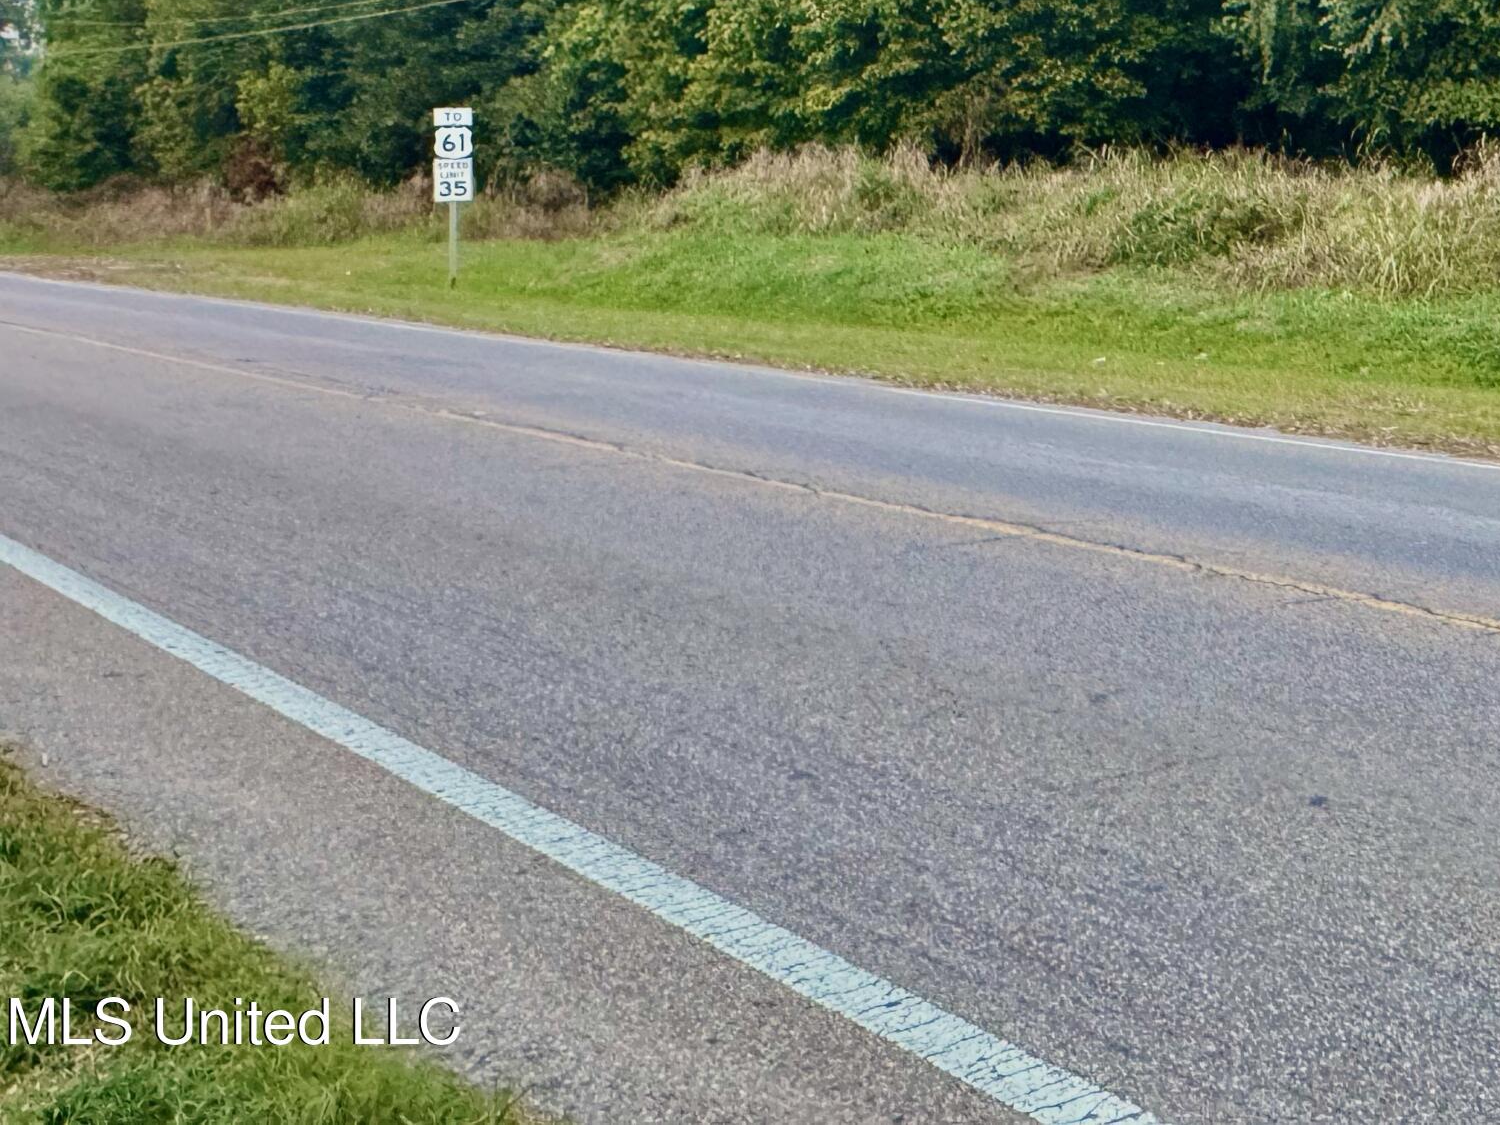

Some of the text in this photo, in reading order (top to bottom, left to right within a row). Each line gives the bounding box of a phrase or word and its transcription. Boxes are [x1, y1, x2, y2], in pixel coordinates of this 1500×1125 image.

[444, 112, 462, 122] TO
[442, 133, 464, 152] 61
[438, 162, 469, 170] SPEED
[440, 171, 465, 179] LIMIT
[439, 180, 467, 197] 35
